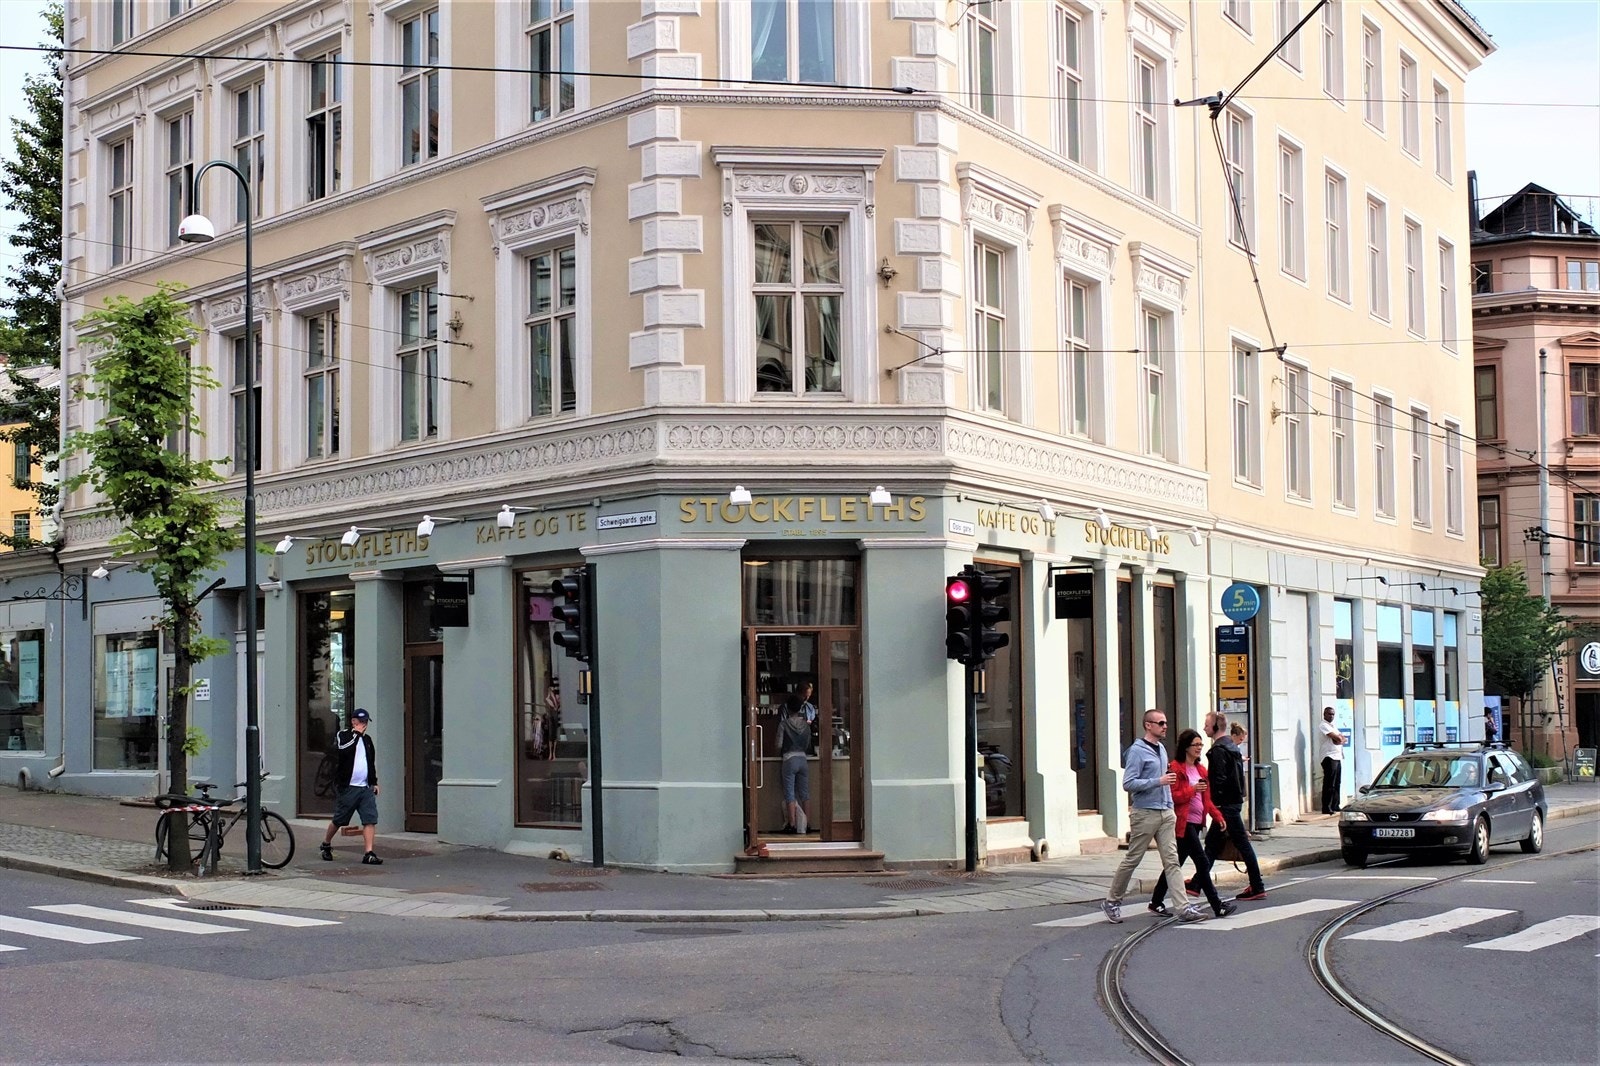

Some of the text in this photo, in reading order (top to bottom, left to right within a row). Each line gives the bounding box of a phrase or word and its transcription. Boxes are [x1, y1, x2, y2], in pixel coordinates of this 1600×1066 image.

[599, 515, 653, 528] Schweigaards gate
[680, 496, 926, 523] STOCKFLETHS
[977, 508, 1016, 532] KAFFE
[1020, 514, 1039, 535] OG
[476, 512, 587, 544] KAFFE OG TE
[306, 529, 429, 565] STOCKFLETHS
[1232, 589, 1245, 608] 5
[1390, 829, 1414, 837] 27281
